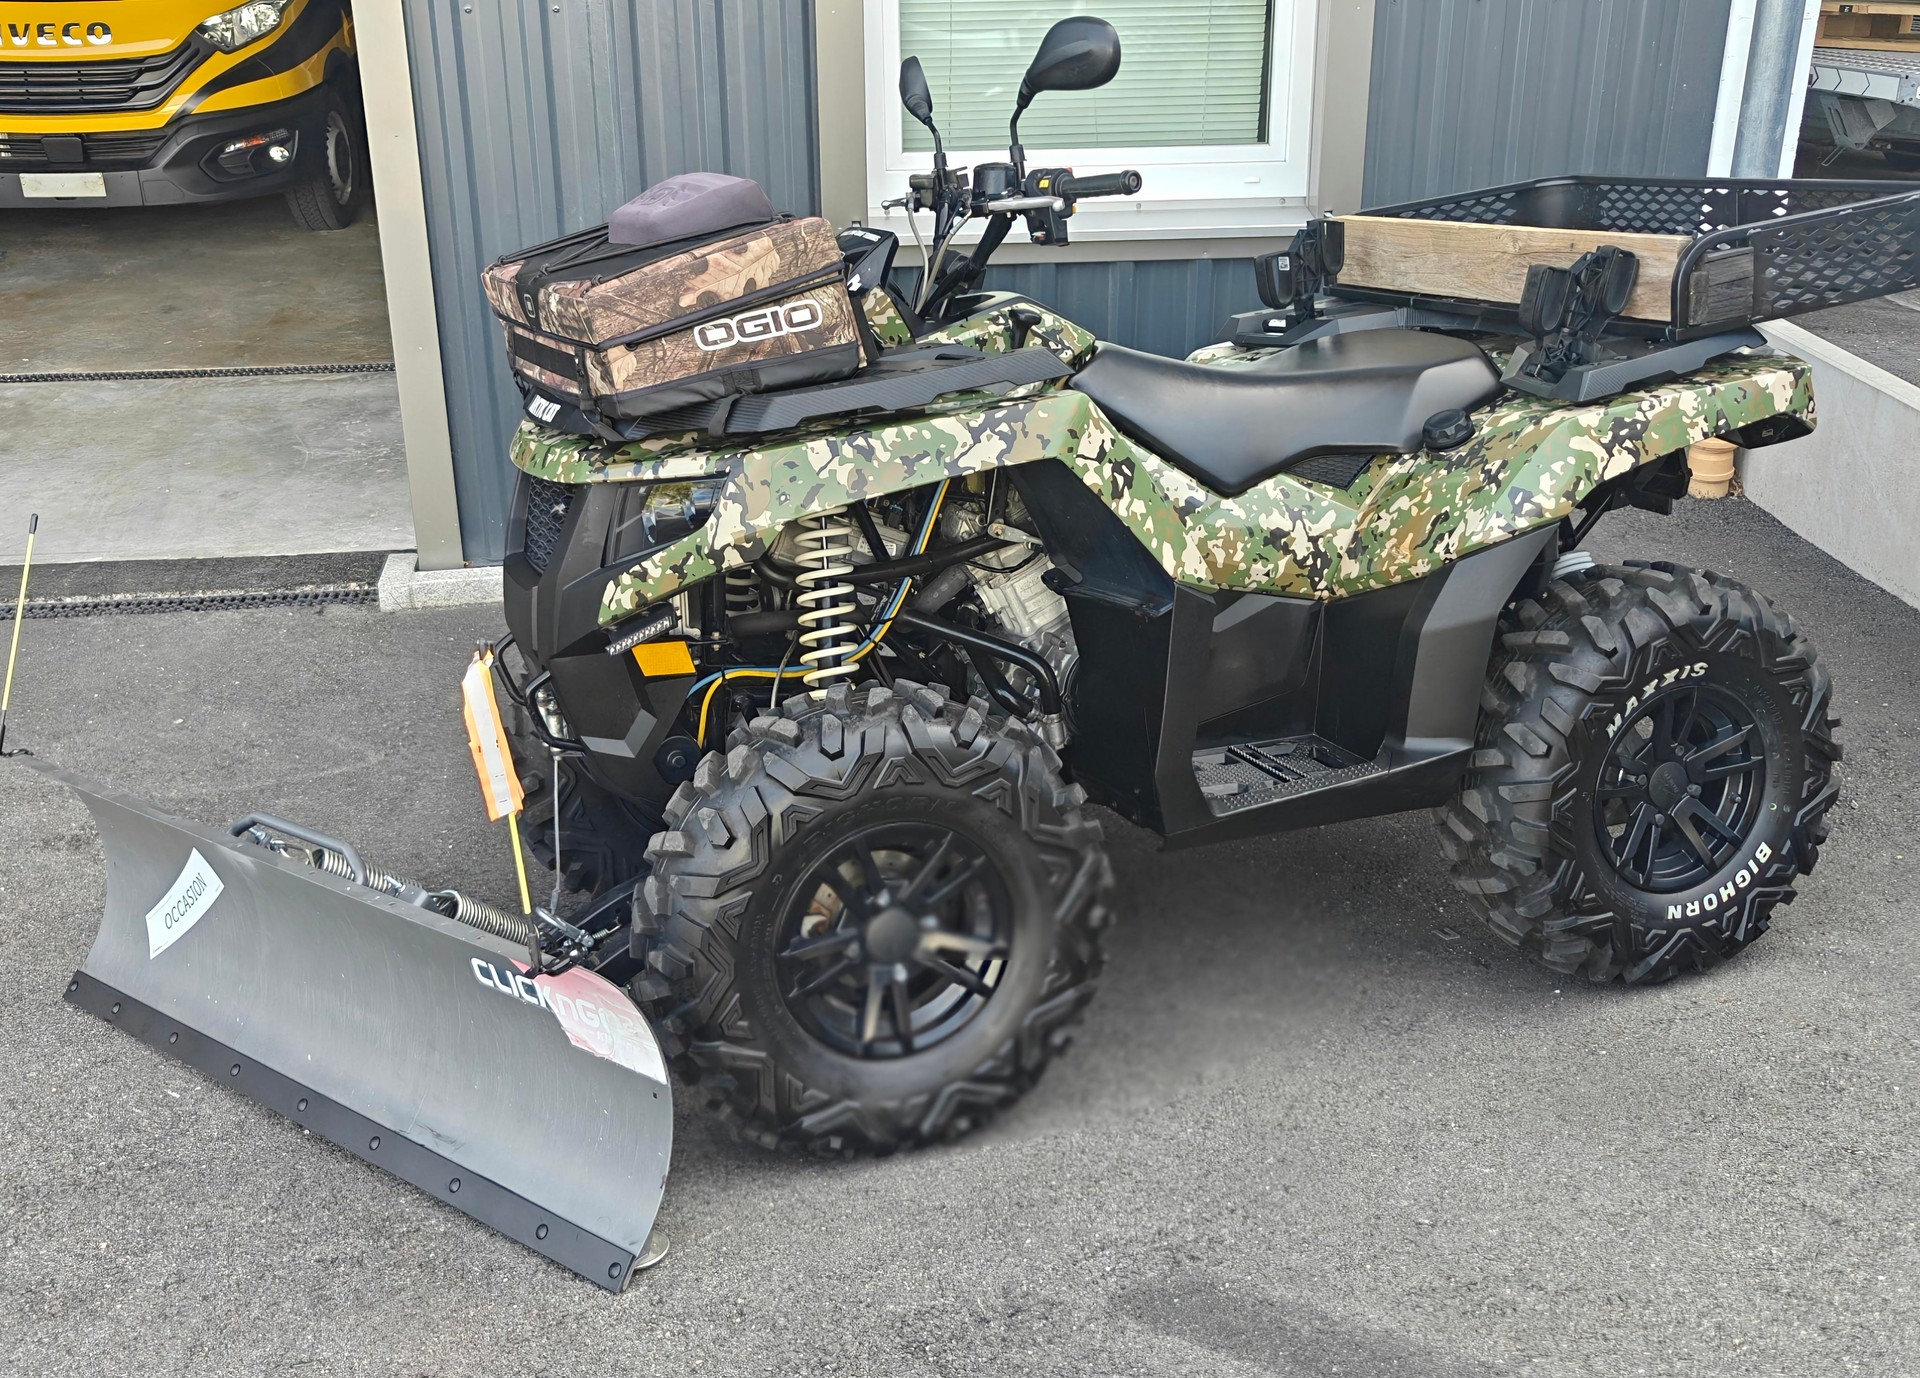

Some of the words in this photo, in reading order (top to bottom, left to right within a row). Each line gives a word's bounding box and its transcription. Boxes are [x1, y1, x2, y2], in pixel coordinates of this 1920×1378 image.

[0, 22, 112, 46] VECO
[694, 299, 823, 351] OGIO
[1605, 662, 1708, 739] MAXXIS
[164, 872, 207, 929] OCCASION
[1667, 841, 1772, 919] BIGHORN
